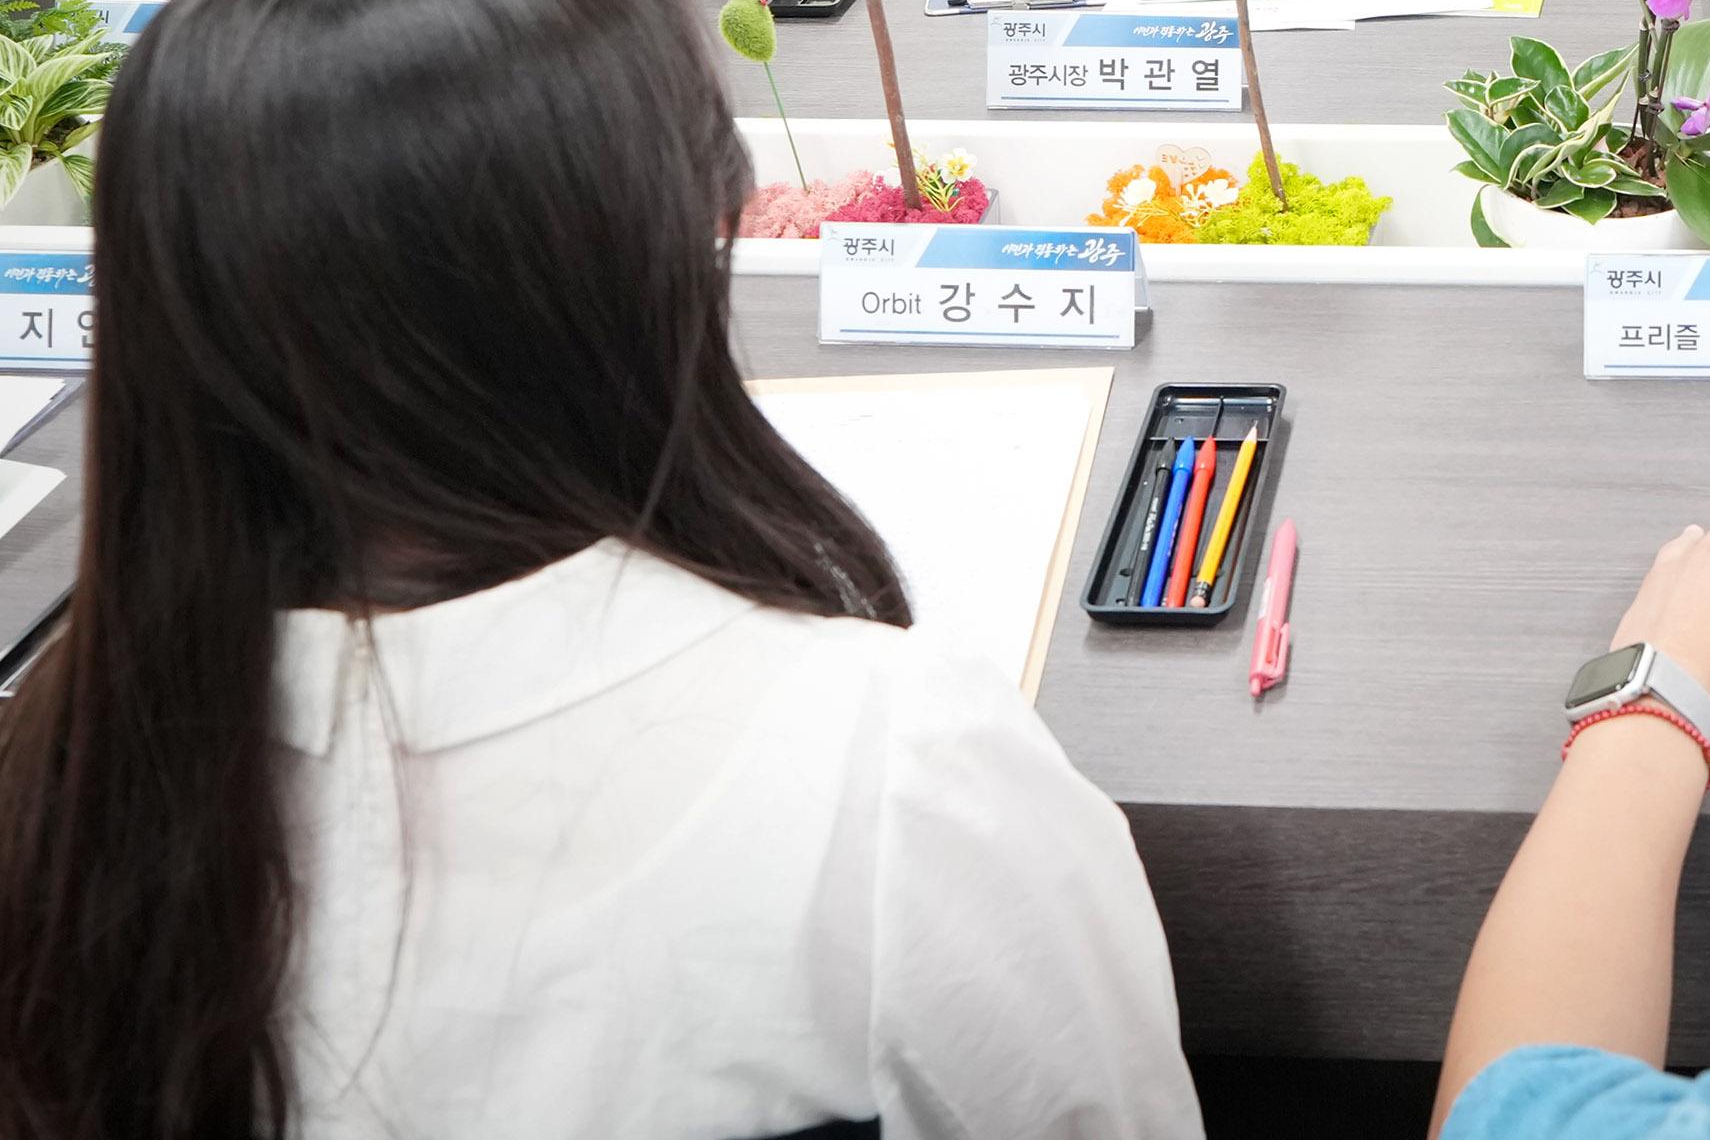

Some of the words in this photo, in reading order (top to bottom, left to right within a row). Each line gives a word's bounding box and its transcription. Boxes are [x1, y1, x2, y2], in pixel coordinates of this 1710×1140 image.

[1003, 22, 1046, 38] 광주시
[1195, 20, 1234, 45] 광주
[1008, 64, 1088, 87] 광주시장
[843, 238, 895, 256] 광주시
[1078, 237, 1126, 267] 광주
[1606, 270, 1662, 289] 광주시
[861, 291, 922, 315] Orbit
[1619, 323, 1701, 351] 프리즐
